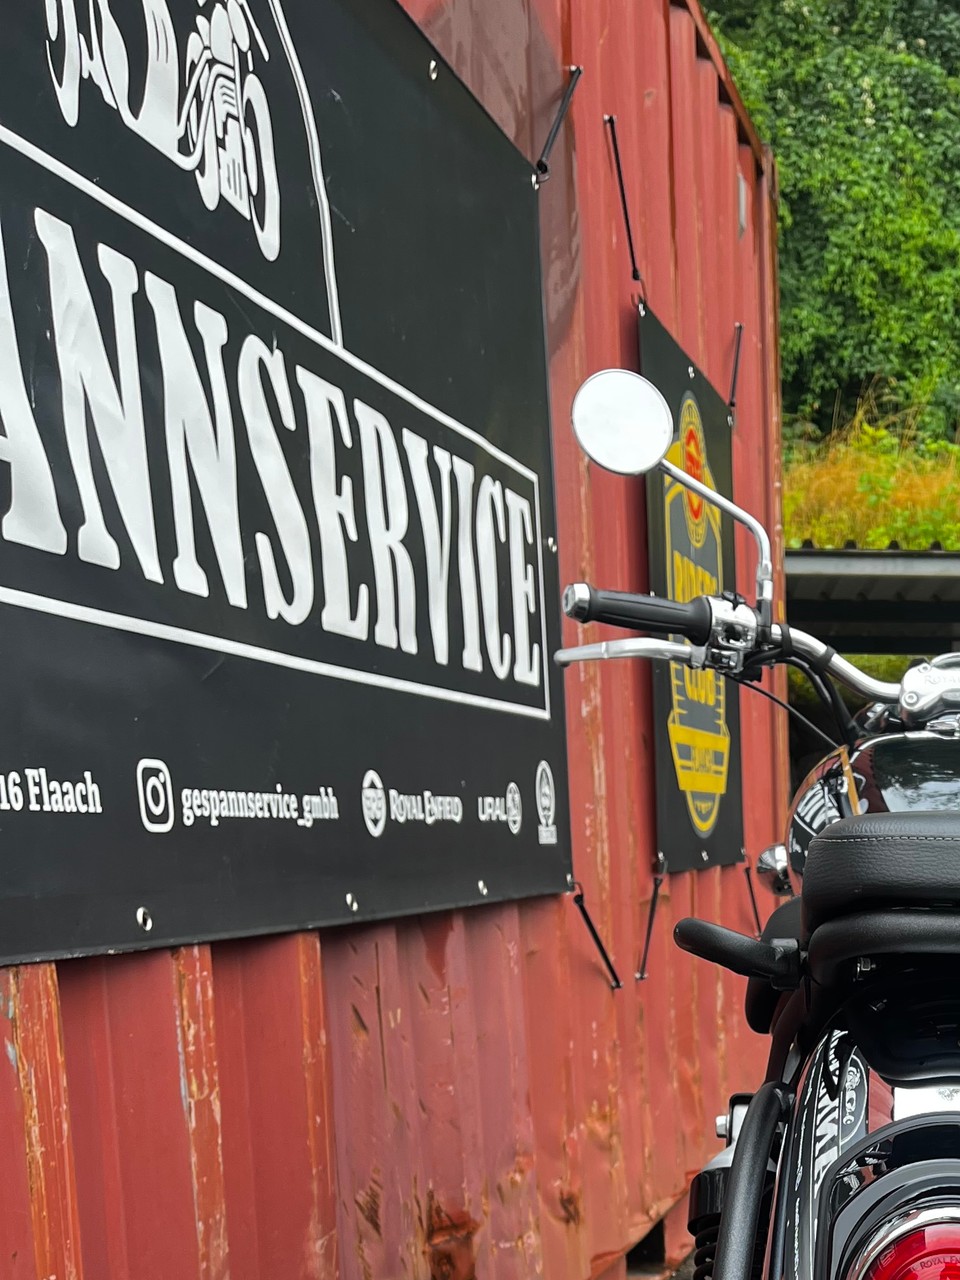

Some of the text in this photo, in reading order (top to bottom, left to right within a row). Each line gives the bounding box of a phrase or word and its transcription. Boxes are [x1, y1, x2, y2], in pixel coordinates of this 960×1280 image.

[24, 768, 102, 813] Flaach
[181, 783, 339, 827] gespannservice_gmbh
[388, 788, 463, 825] ROYAL ENFIELD
[920, 1256, 946, 1270] ROYAL
